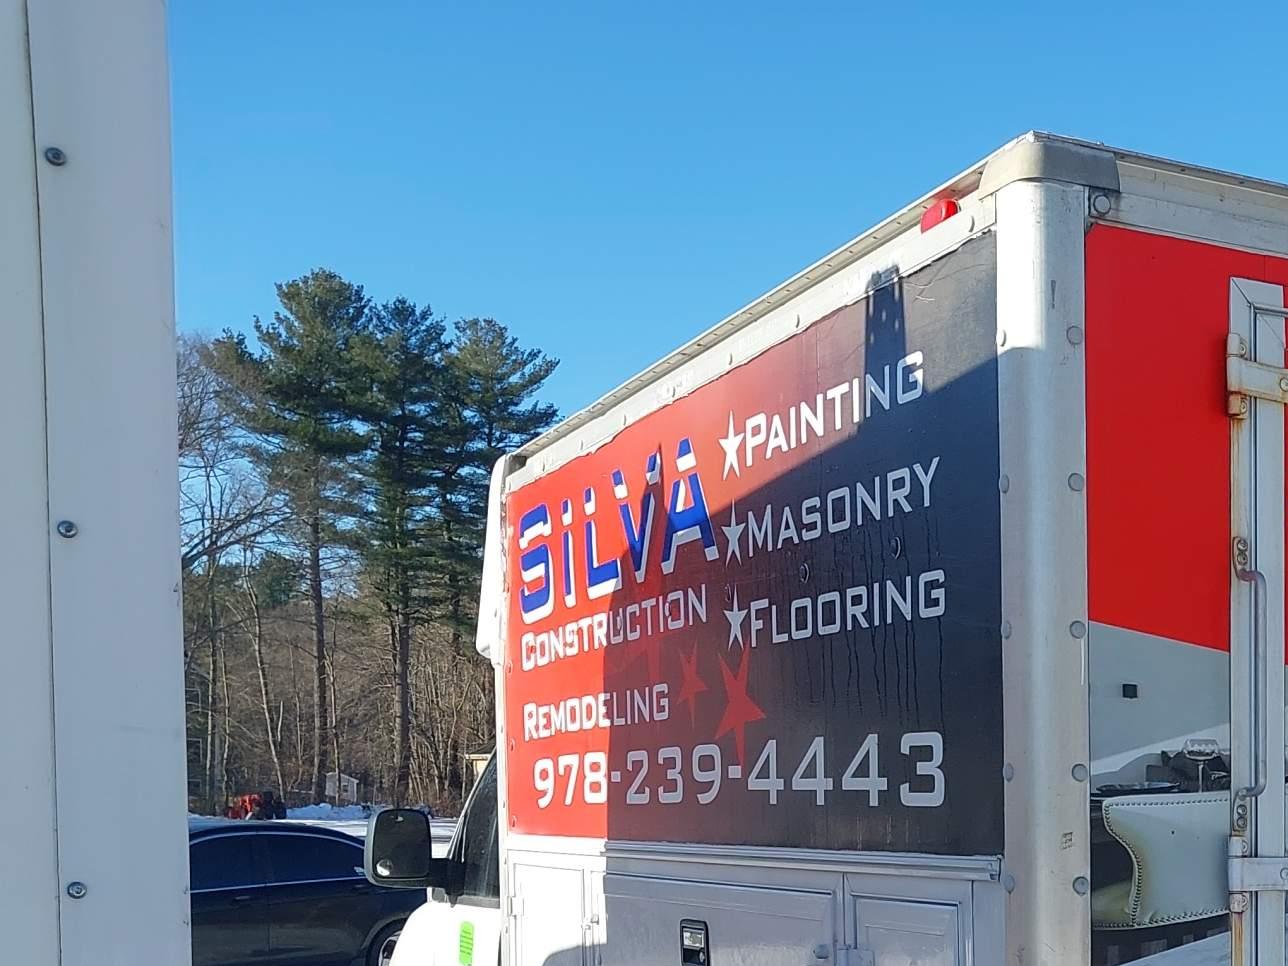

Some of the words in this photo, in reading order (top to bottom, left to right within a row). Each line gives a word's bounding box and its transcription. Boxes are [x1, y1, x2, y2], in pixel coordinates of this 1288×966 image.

[744, 350, 924, 467] PAINTING
[747, 456, 941, 558] MASONRY
[520, 583, 708, 672] CONSTRUCTION
[750, 568, 947, 649] FLOORING
[523, 682, 670, 742] REMODELING
[532, 730, 947, 809] 978-239-4443
